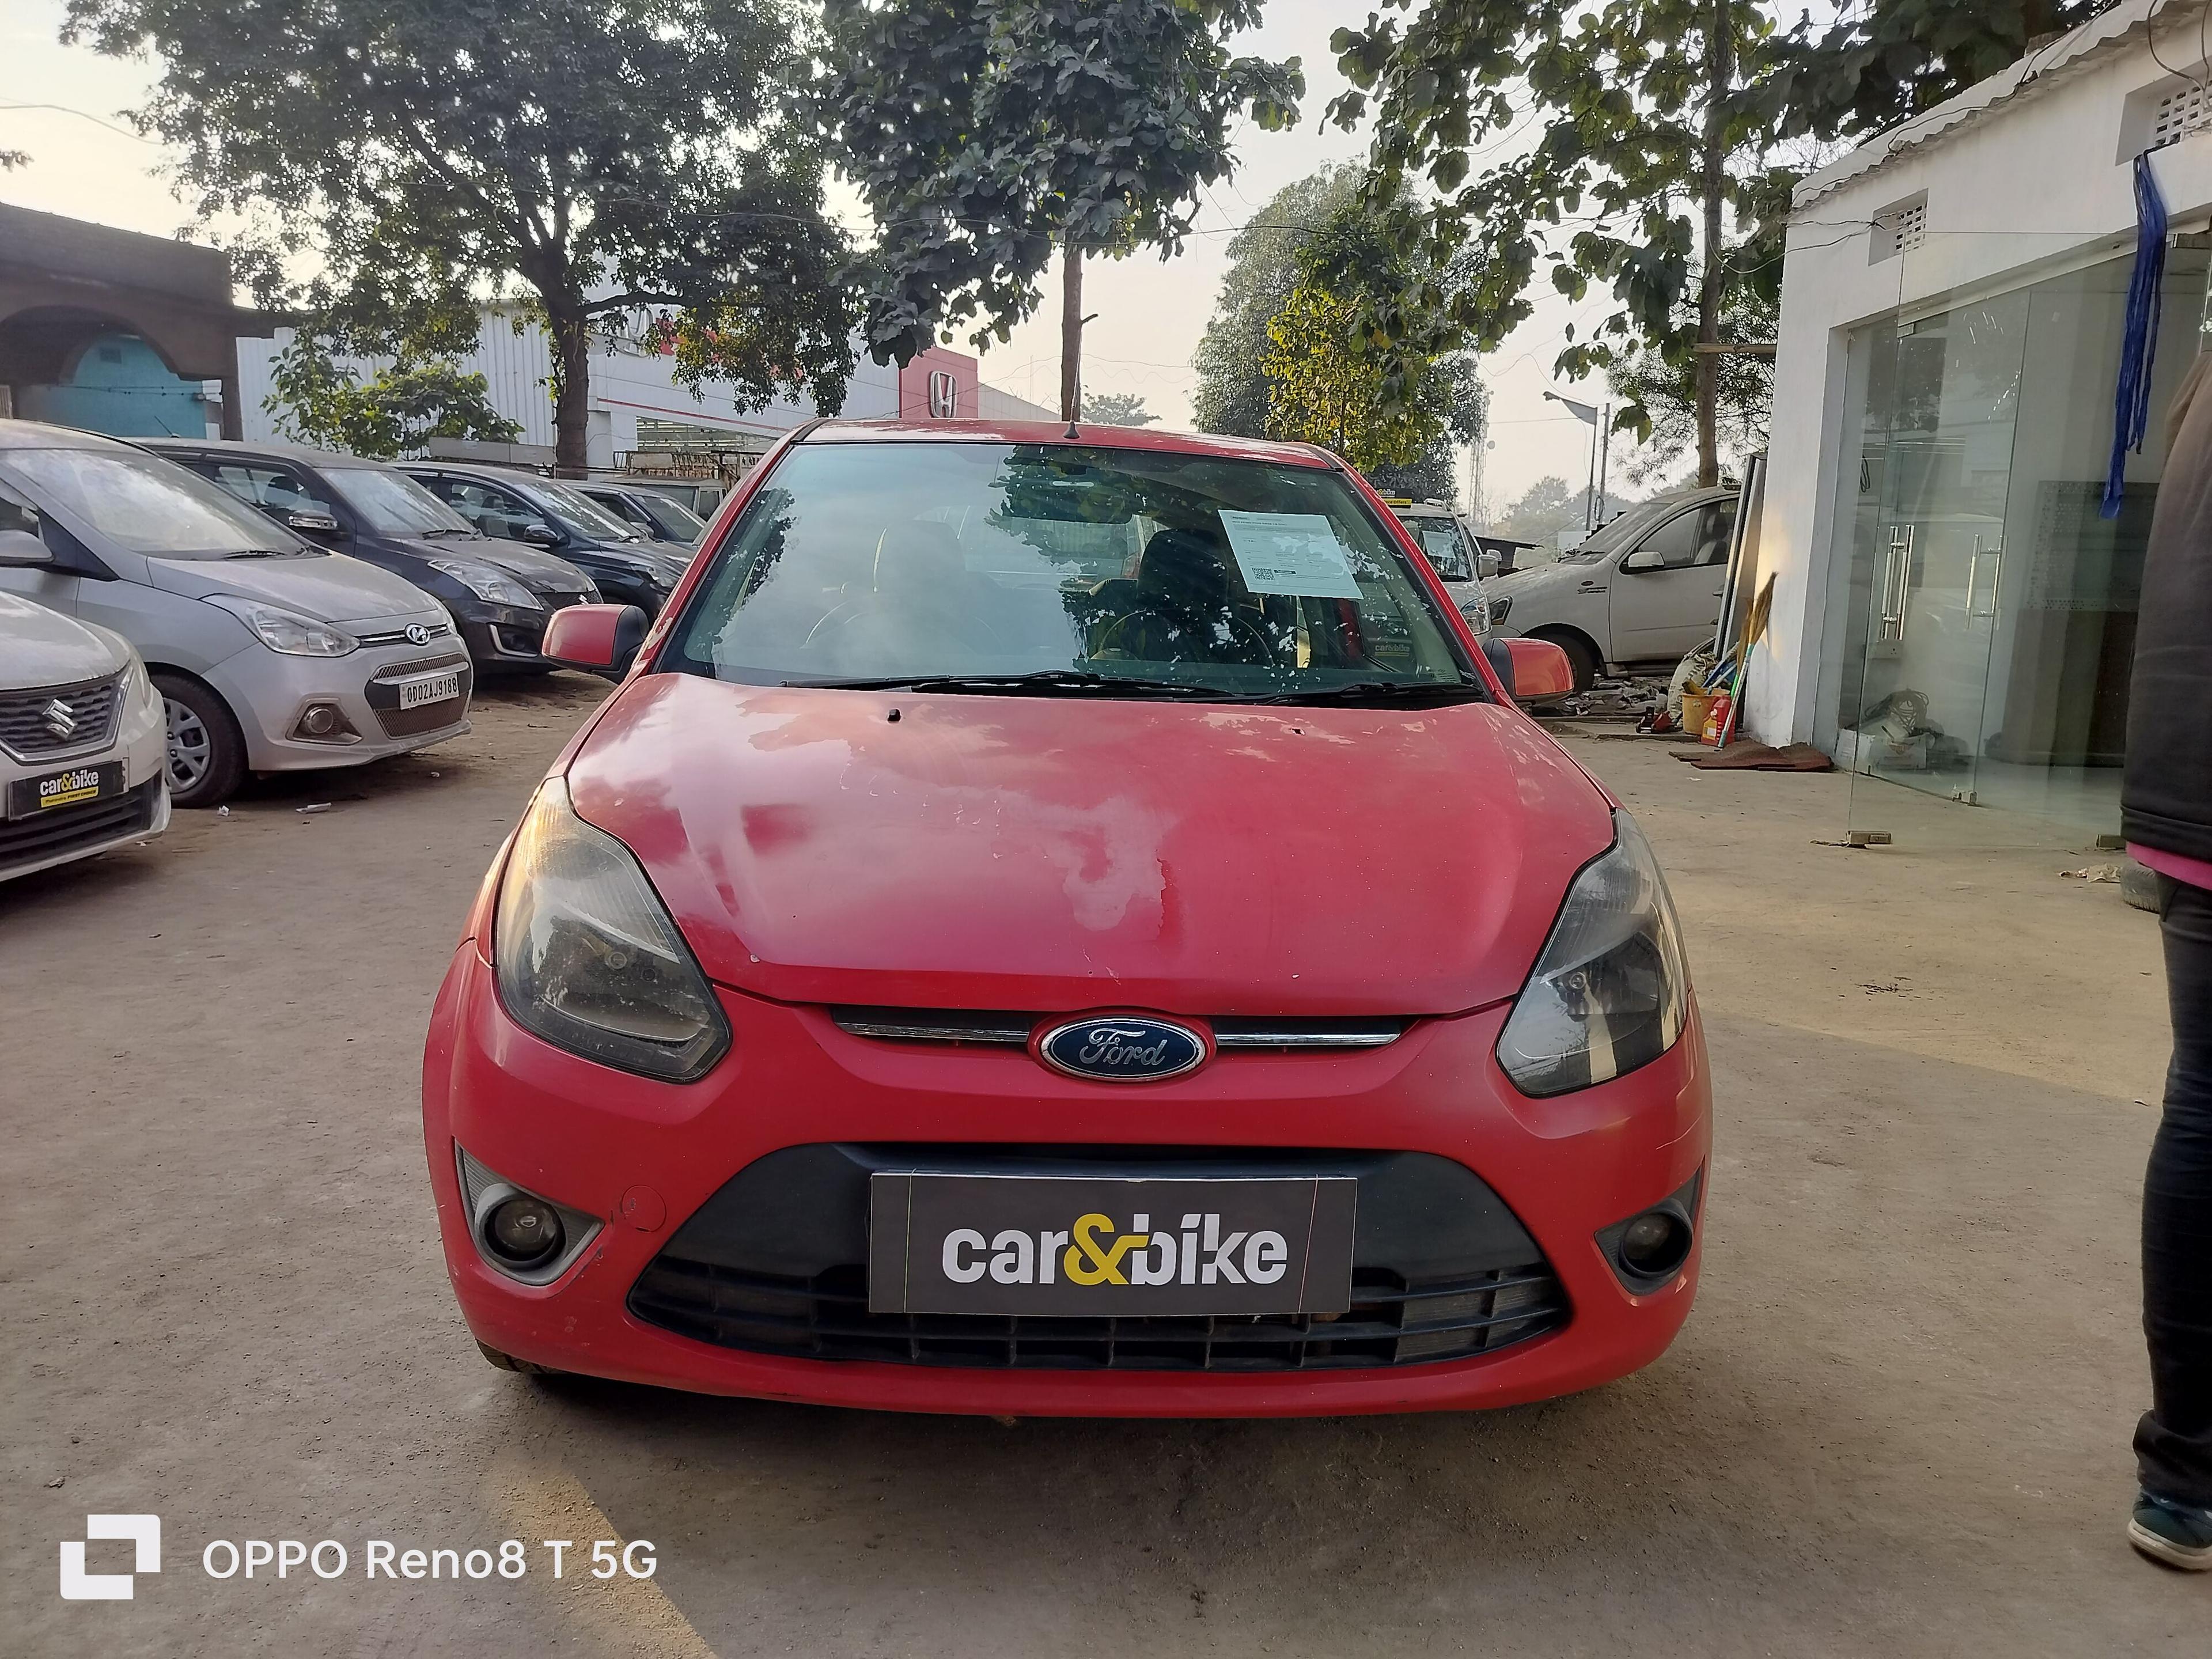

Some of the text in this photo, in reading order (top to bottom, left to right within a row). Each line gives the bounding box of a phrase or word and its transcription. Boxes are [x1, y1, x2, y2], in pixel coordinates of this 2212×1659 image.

[407, 677, 457, 703] OD02AJ9188
[40, 769, 99, 796] car&bike
[1079, 1028, 1168, 1066] Ford
[942, 1213, 1288, 1286] car&bike
